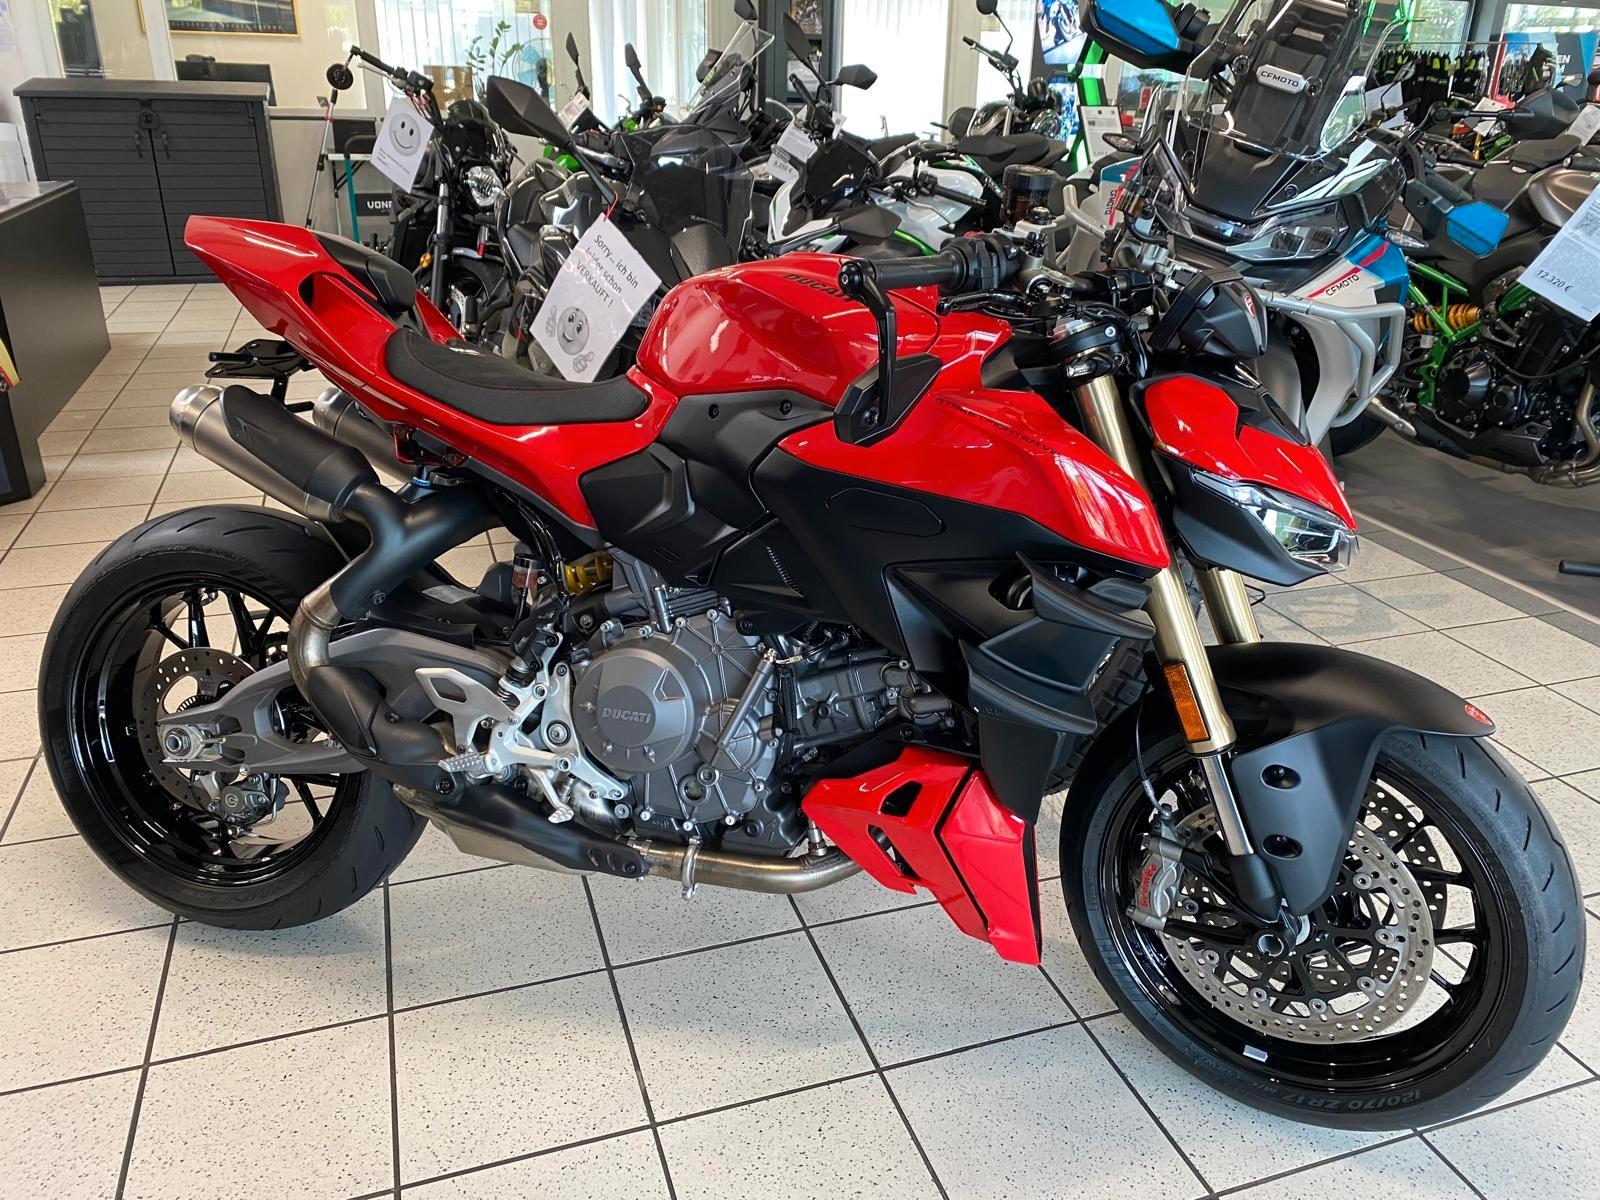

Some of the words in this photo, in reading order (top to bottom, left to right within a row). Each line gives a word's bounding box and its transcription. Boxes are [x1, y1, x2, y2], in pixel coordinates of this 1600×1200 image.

[1260, 70, 1300, 88] CFMOTO
[1104, 189, 1118, 216] CFMOTO
[576, 260, 610, 303] VERKAUFT
[585, 246, 603, 272] leider
[603, 268, 622, 294] schon
[615, 259, 629, 277] ich
[626, 272, 639, 289] bin
[1536, 268, 1566, 289] 12.320
[1564, 284, 1574, 293] €
[1325, 274, 1360, 297] CFMOTO
[601, 707, 652, 724] DUCATI
[1347, 1087, 1421, 1111] 120/70
